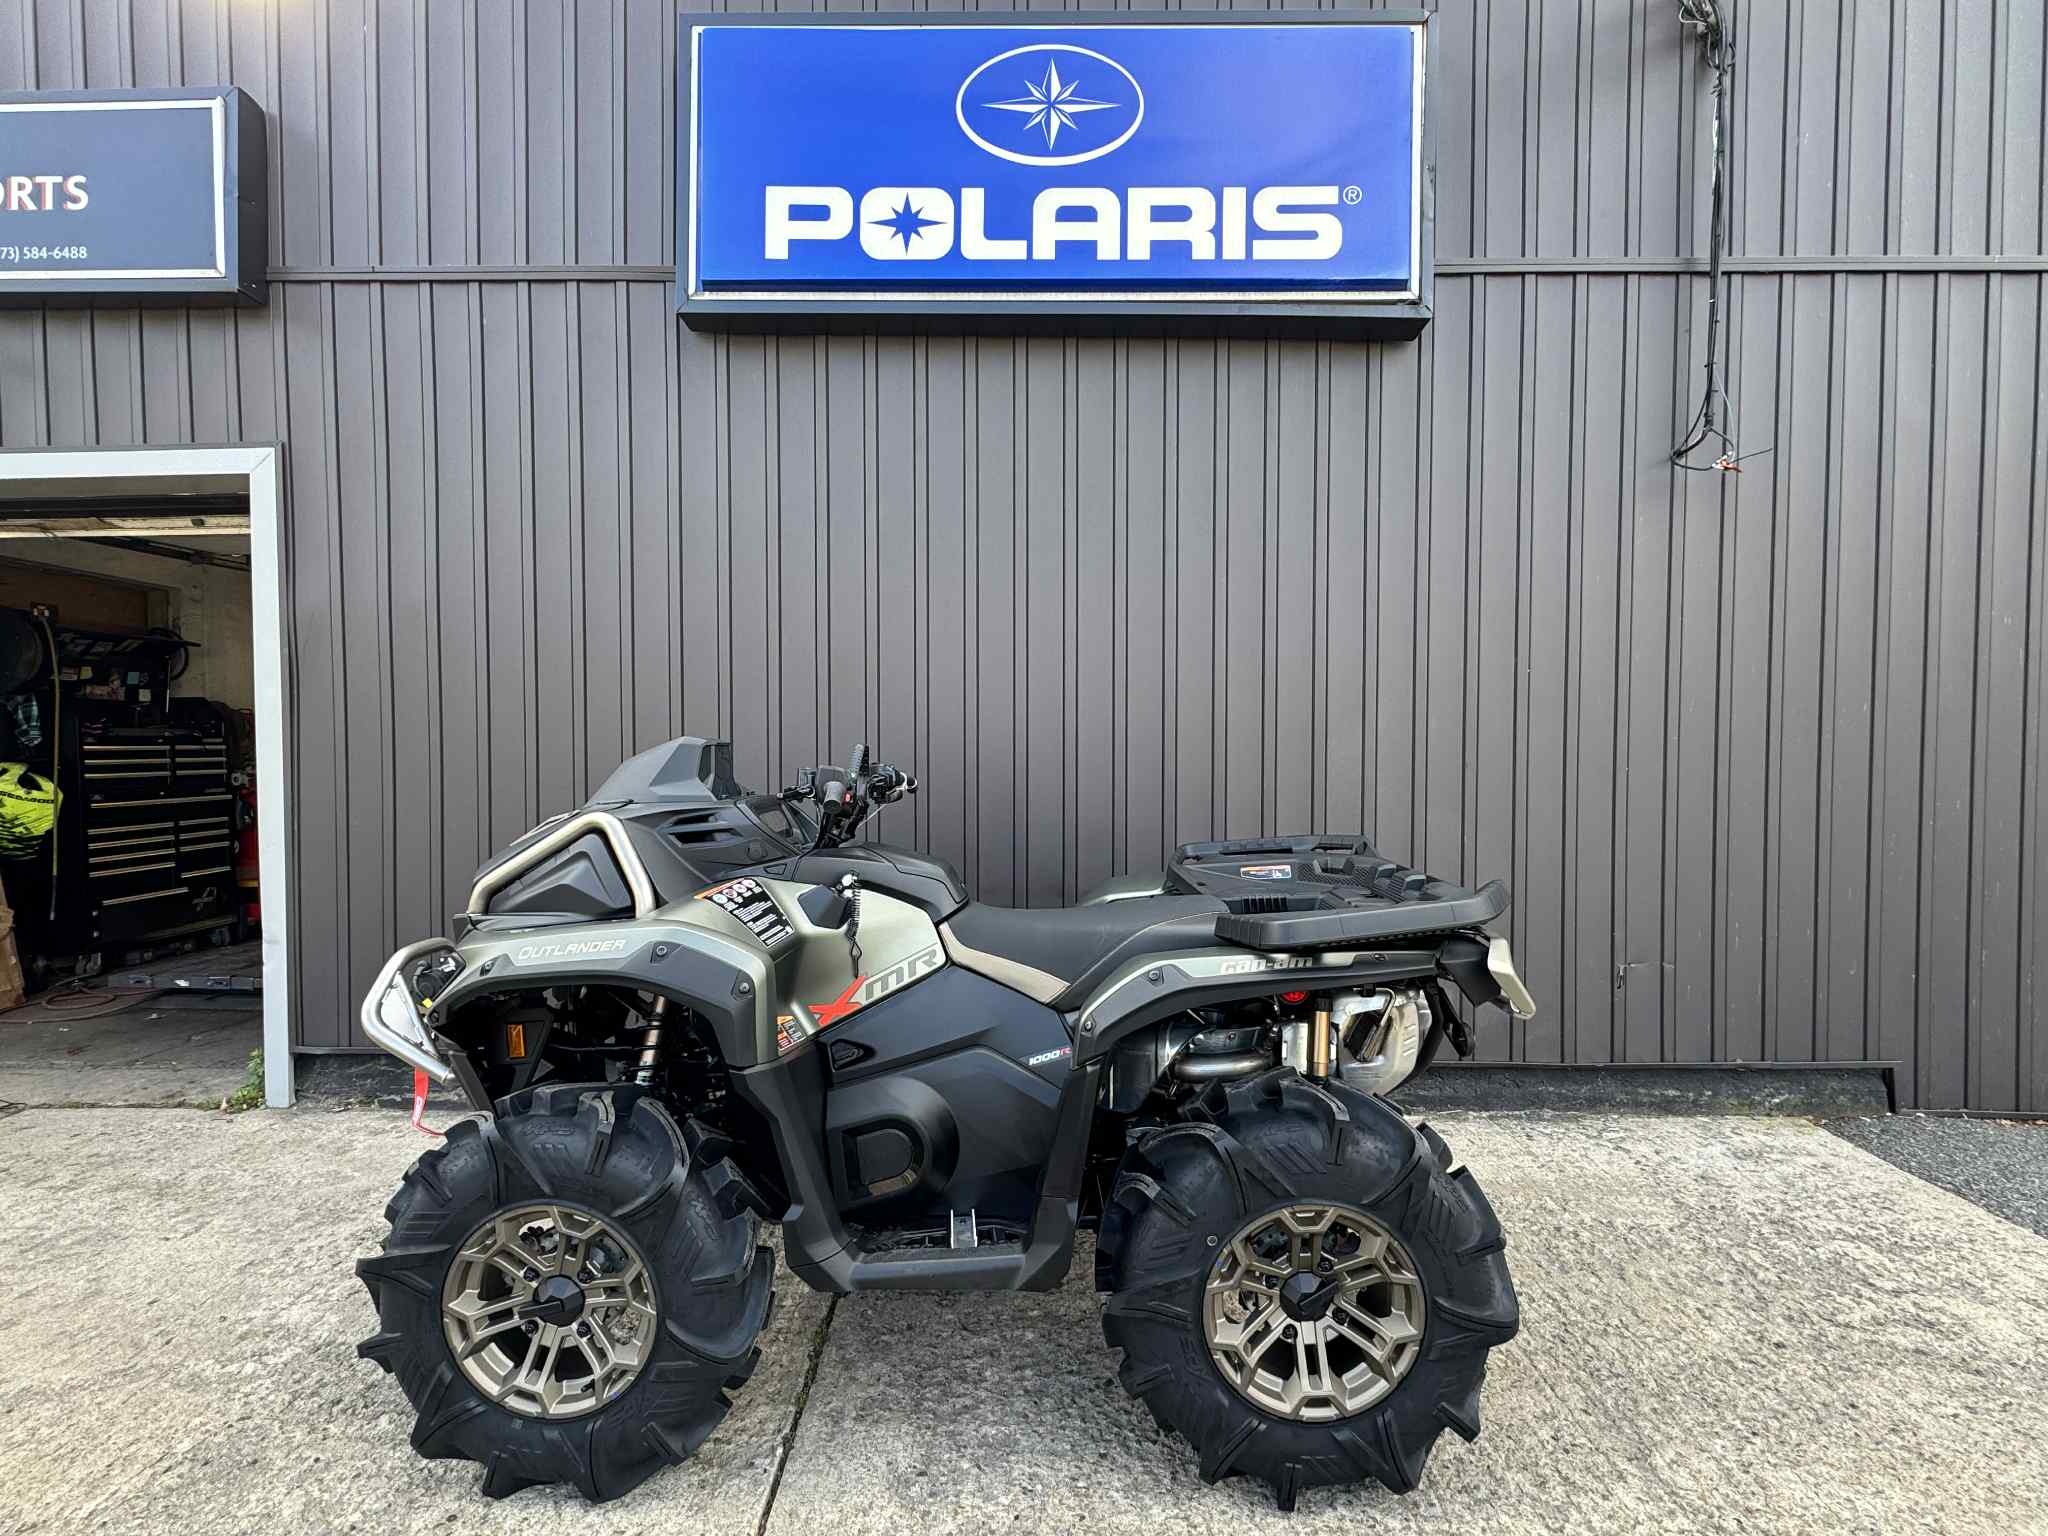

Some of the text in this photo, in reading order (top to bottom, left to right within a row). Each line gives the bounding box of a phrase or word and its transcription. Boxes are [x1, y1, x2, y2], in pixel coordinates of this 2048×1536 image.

[0, 175, 89, 210] RTS
[23, 246, 88, 260] 584-6488
[518, 939, 626, 960] OUTLANDER
